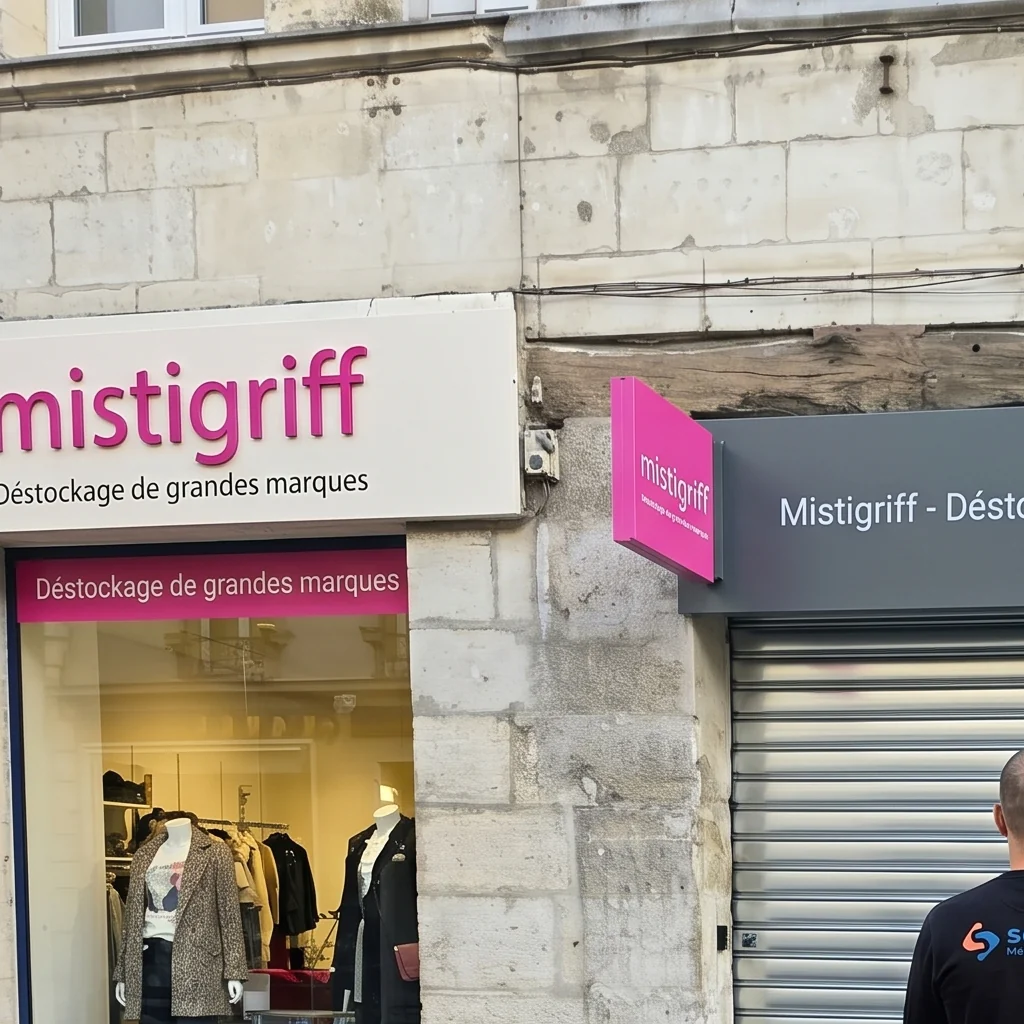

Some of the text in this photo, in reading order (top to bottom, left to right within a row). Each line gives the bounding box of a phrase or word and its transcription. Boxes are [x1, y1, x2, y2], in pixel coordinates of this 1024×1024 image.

[0, 345, 368, 467] mistigriff
[131, 475, 160, 500] de
[166, 470, 260, 505] grandes
[266, 473, 369, 499] marques
[640, 454, 710, 515] mistigriff
[780, 491, 919, 532] Mistigriff
[36, 570, 400, 603] Déstockage de grandes marques
